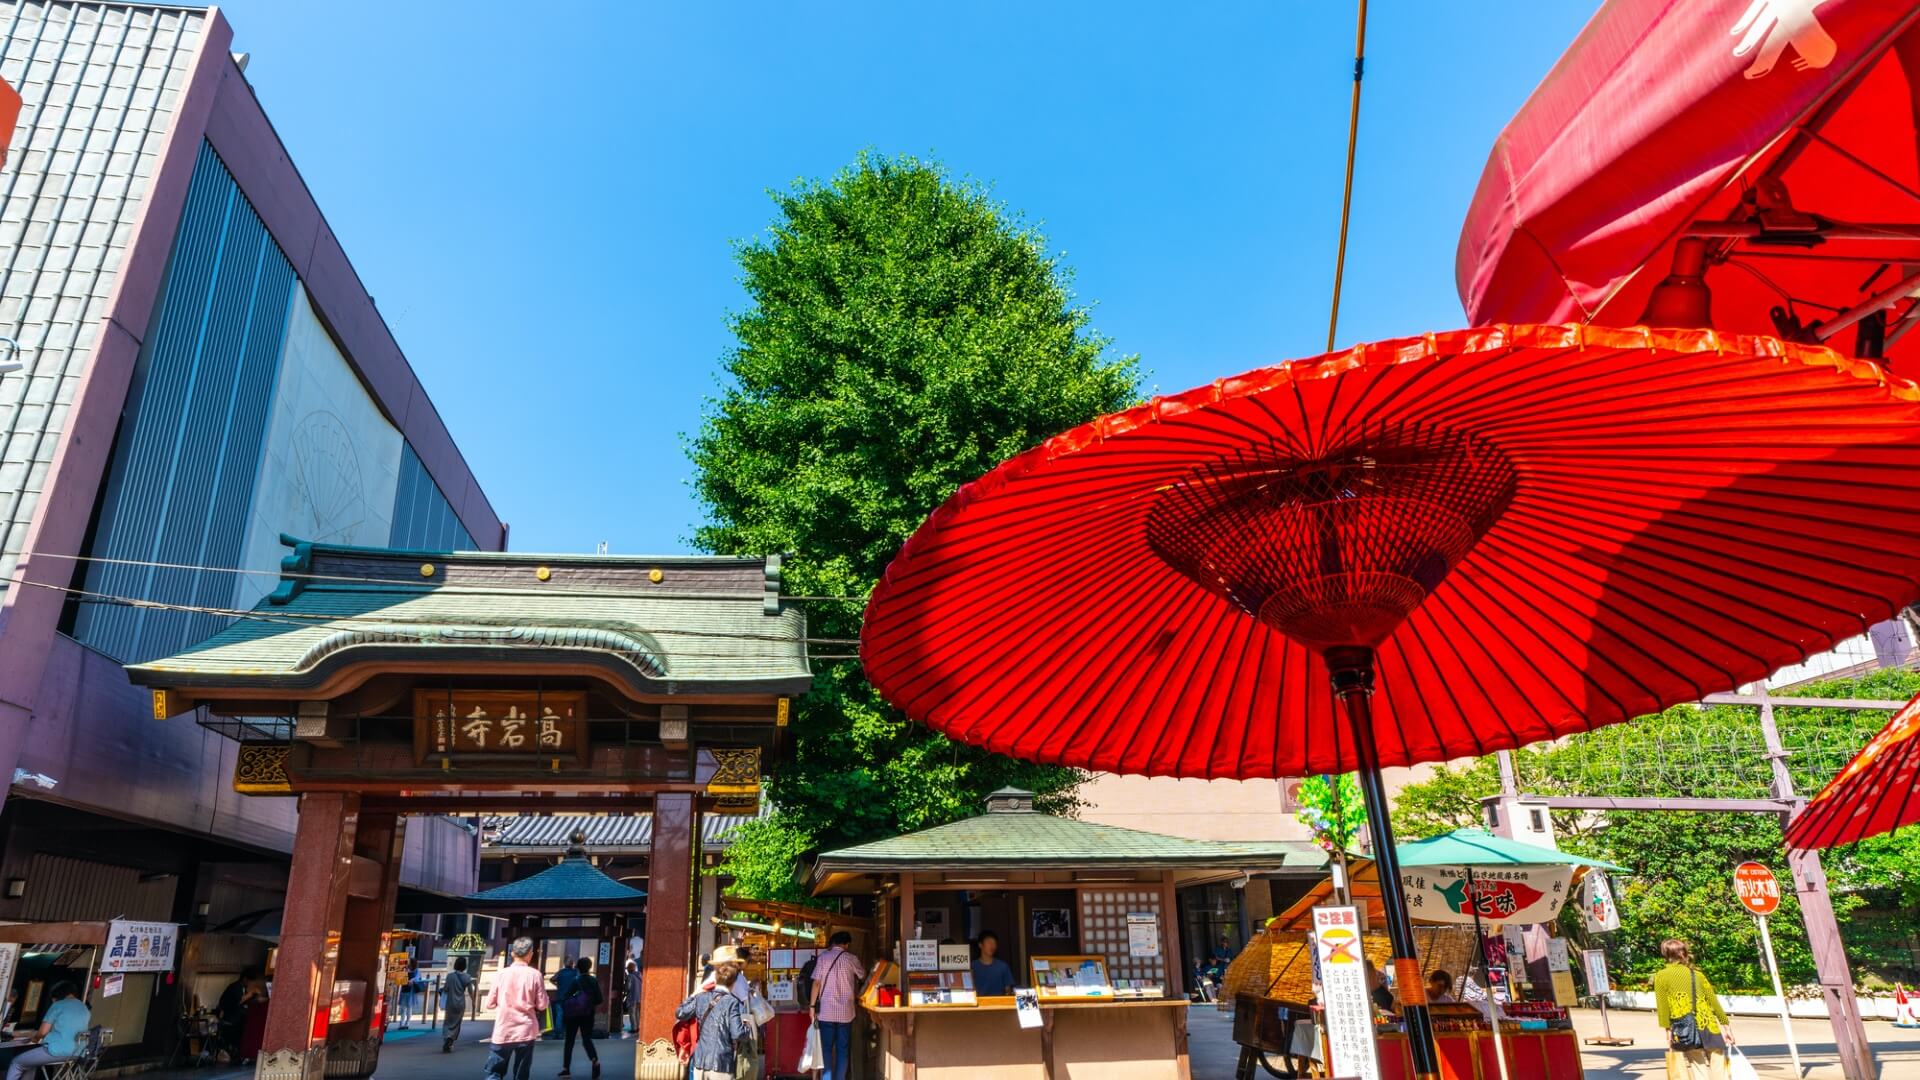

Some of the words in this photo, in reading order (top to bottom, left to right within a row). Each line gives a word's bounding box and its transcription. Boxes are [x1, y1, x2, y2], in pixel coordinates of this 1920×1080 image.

[462, 705, 562, 748] 高岩寺
[1440, 869, 1529, 881] 巣鴨とぬき地蔵尊名物
[1736, 878, 1779, 898] 防火水槽
[1475, 889, 1517, 914] 七味
[1318, 911, 1355, 925] ご注意
